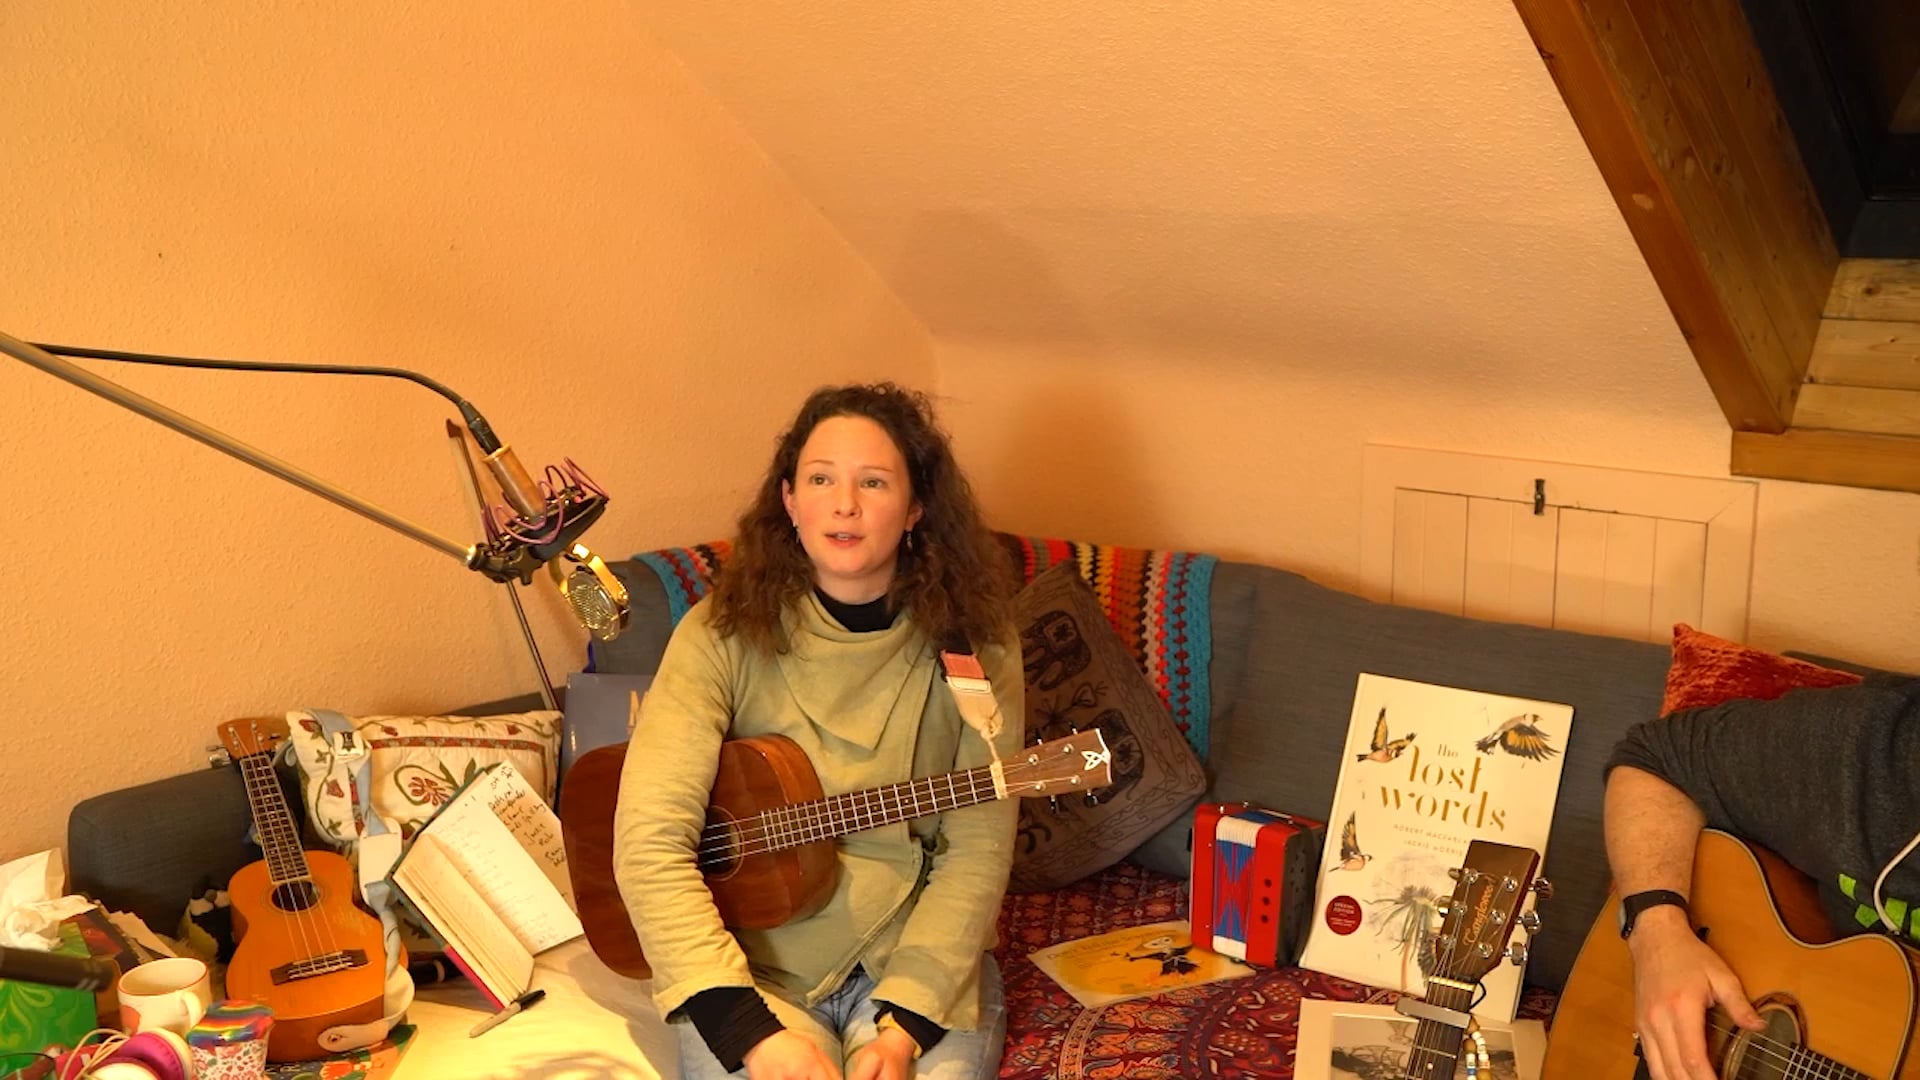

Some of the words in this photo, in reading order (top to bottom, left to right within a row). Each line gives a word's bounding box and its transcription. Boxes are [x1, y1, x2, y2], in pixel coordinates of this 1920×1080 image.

[1408, 744, 1483, 794] lost
[1437, 743, 1459, 759] the
[1380, 785, 1506, 832] words
